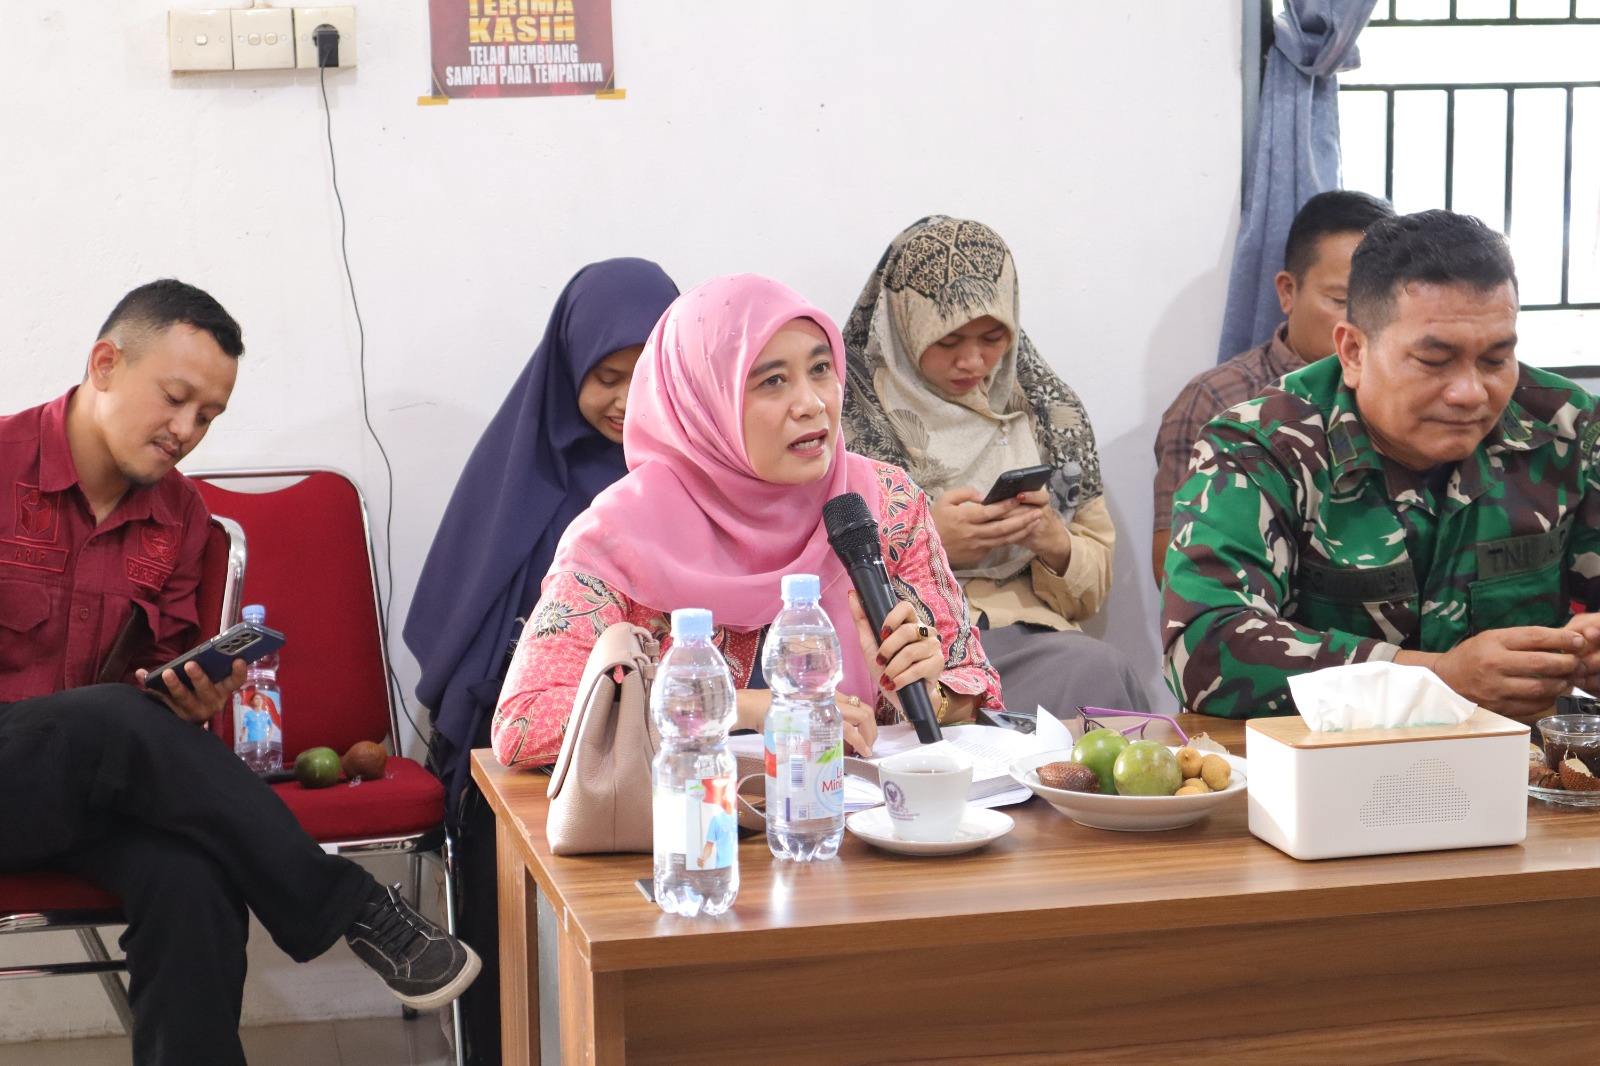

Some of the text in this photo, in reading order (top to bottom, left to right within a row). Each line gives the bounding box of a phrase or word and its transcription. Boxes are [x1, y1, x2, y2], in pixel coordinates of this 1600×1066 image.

[469, 0, 574, 16] TERIMA
[469, 16, 575, 43] KASIH
[469, 44, 578, 65] TELAH MEMBUANG
[446, 62, 604, 86] SAMPAH PADA TEMPATNYA
